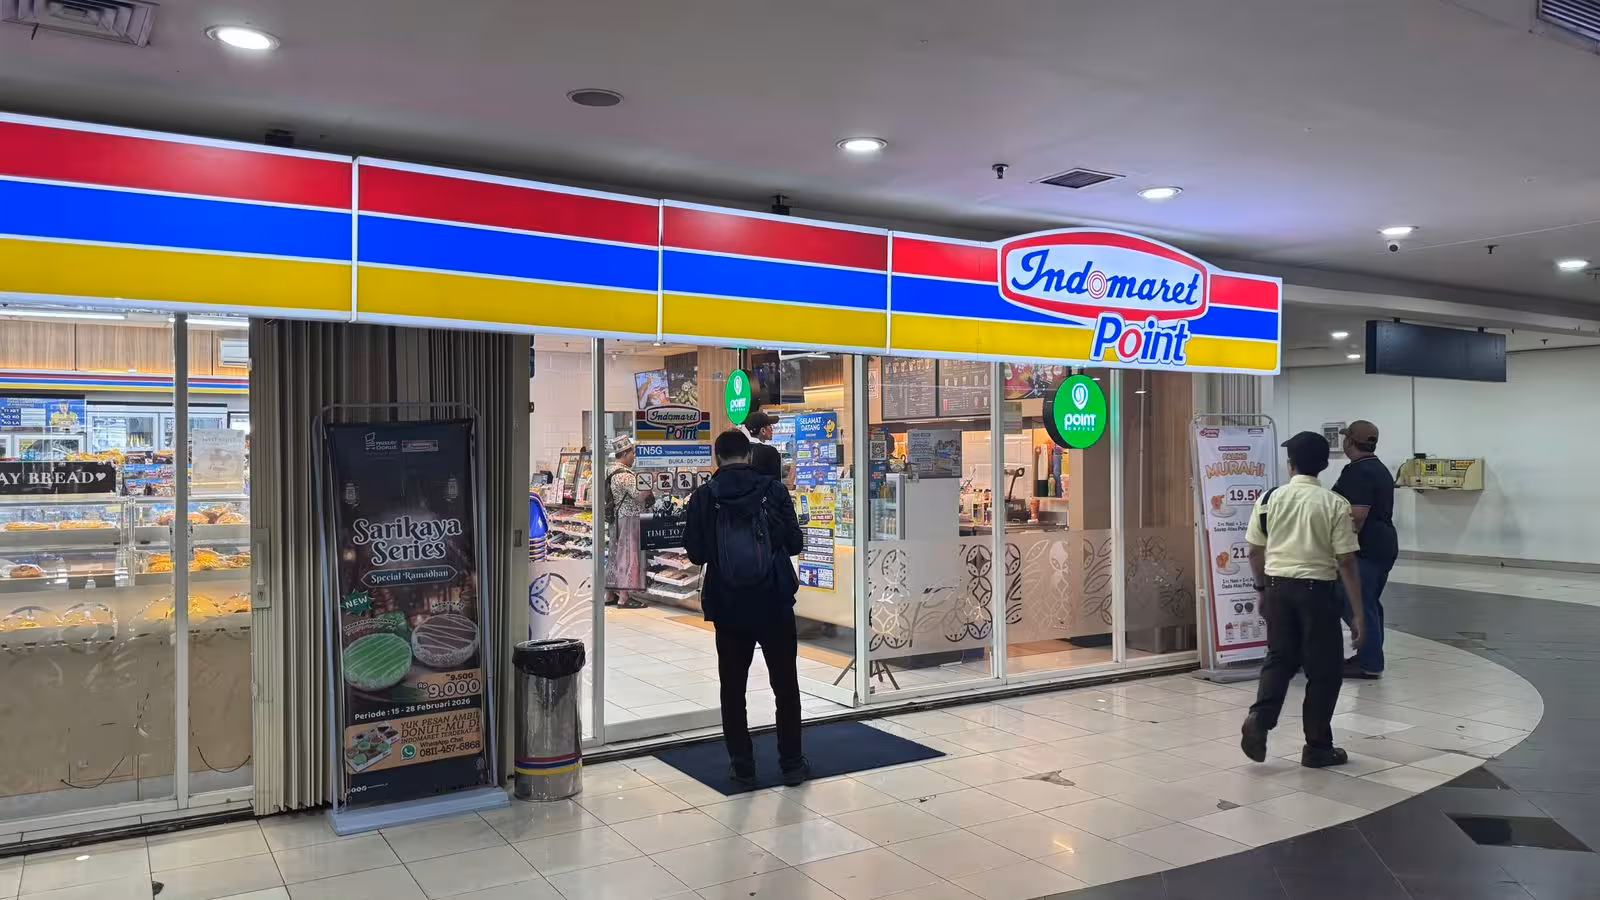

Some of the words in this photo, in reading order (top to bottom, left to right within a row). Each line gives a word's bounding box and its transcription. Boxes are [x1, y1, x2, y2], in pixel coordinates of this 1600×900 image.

[1011, 248, 1201, 306] Indomaret
[1092, 315, 1190, 362] Point
[650, 410, 698, 421] Indomaret
[666, 425, 698, 440] Point
[637, 446, 663, 455] TN5G
[1205, 460, 1266, 479] MURAH!
[28, 472, 95, 485] BREAD
[1229, 488, 1263, 501] 19.5K
[353, 515, 463, 545] Sarikaya
[371, 540, 446, 566] Series
[371, 572, 401, 584] Special
[403, 569, 449, 581] Ramadhan
[345, 595, 368, 610] NEW
[450, 672, 474, 681] 9.500
[428, 679, 480, 698] 9.000
[354, 710, 386, 720] Periode
[391, 707, 399, 715] 15
[406, 705, 415, 713] 28
[417, 701, 451, 711] Februari
[451, 698, 471, 707] 2026
[400, 721, 419, 730] YUK
[421, 714, 450, 727] PESAN
[401, 722, 465, 738] DONUT-MU
[400, 733, 439, 744] INDOMARET
[420, 739, 449, 748] WhatsApp
[419, 740, 480, 758] 0811-457-6868
